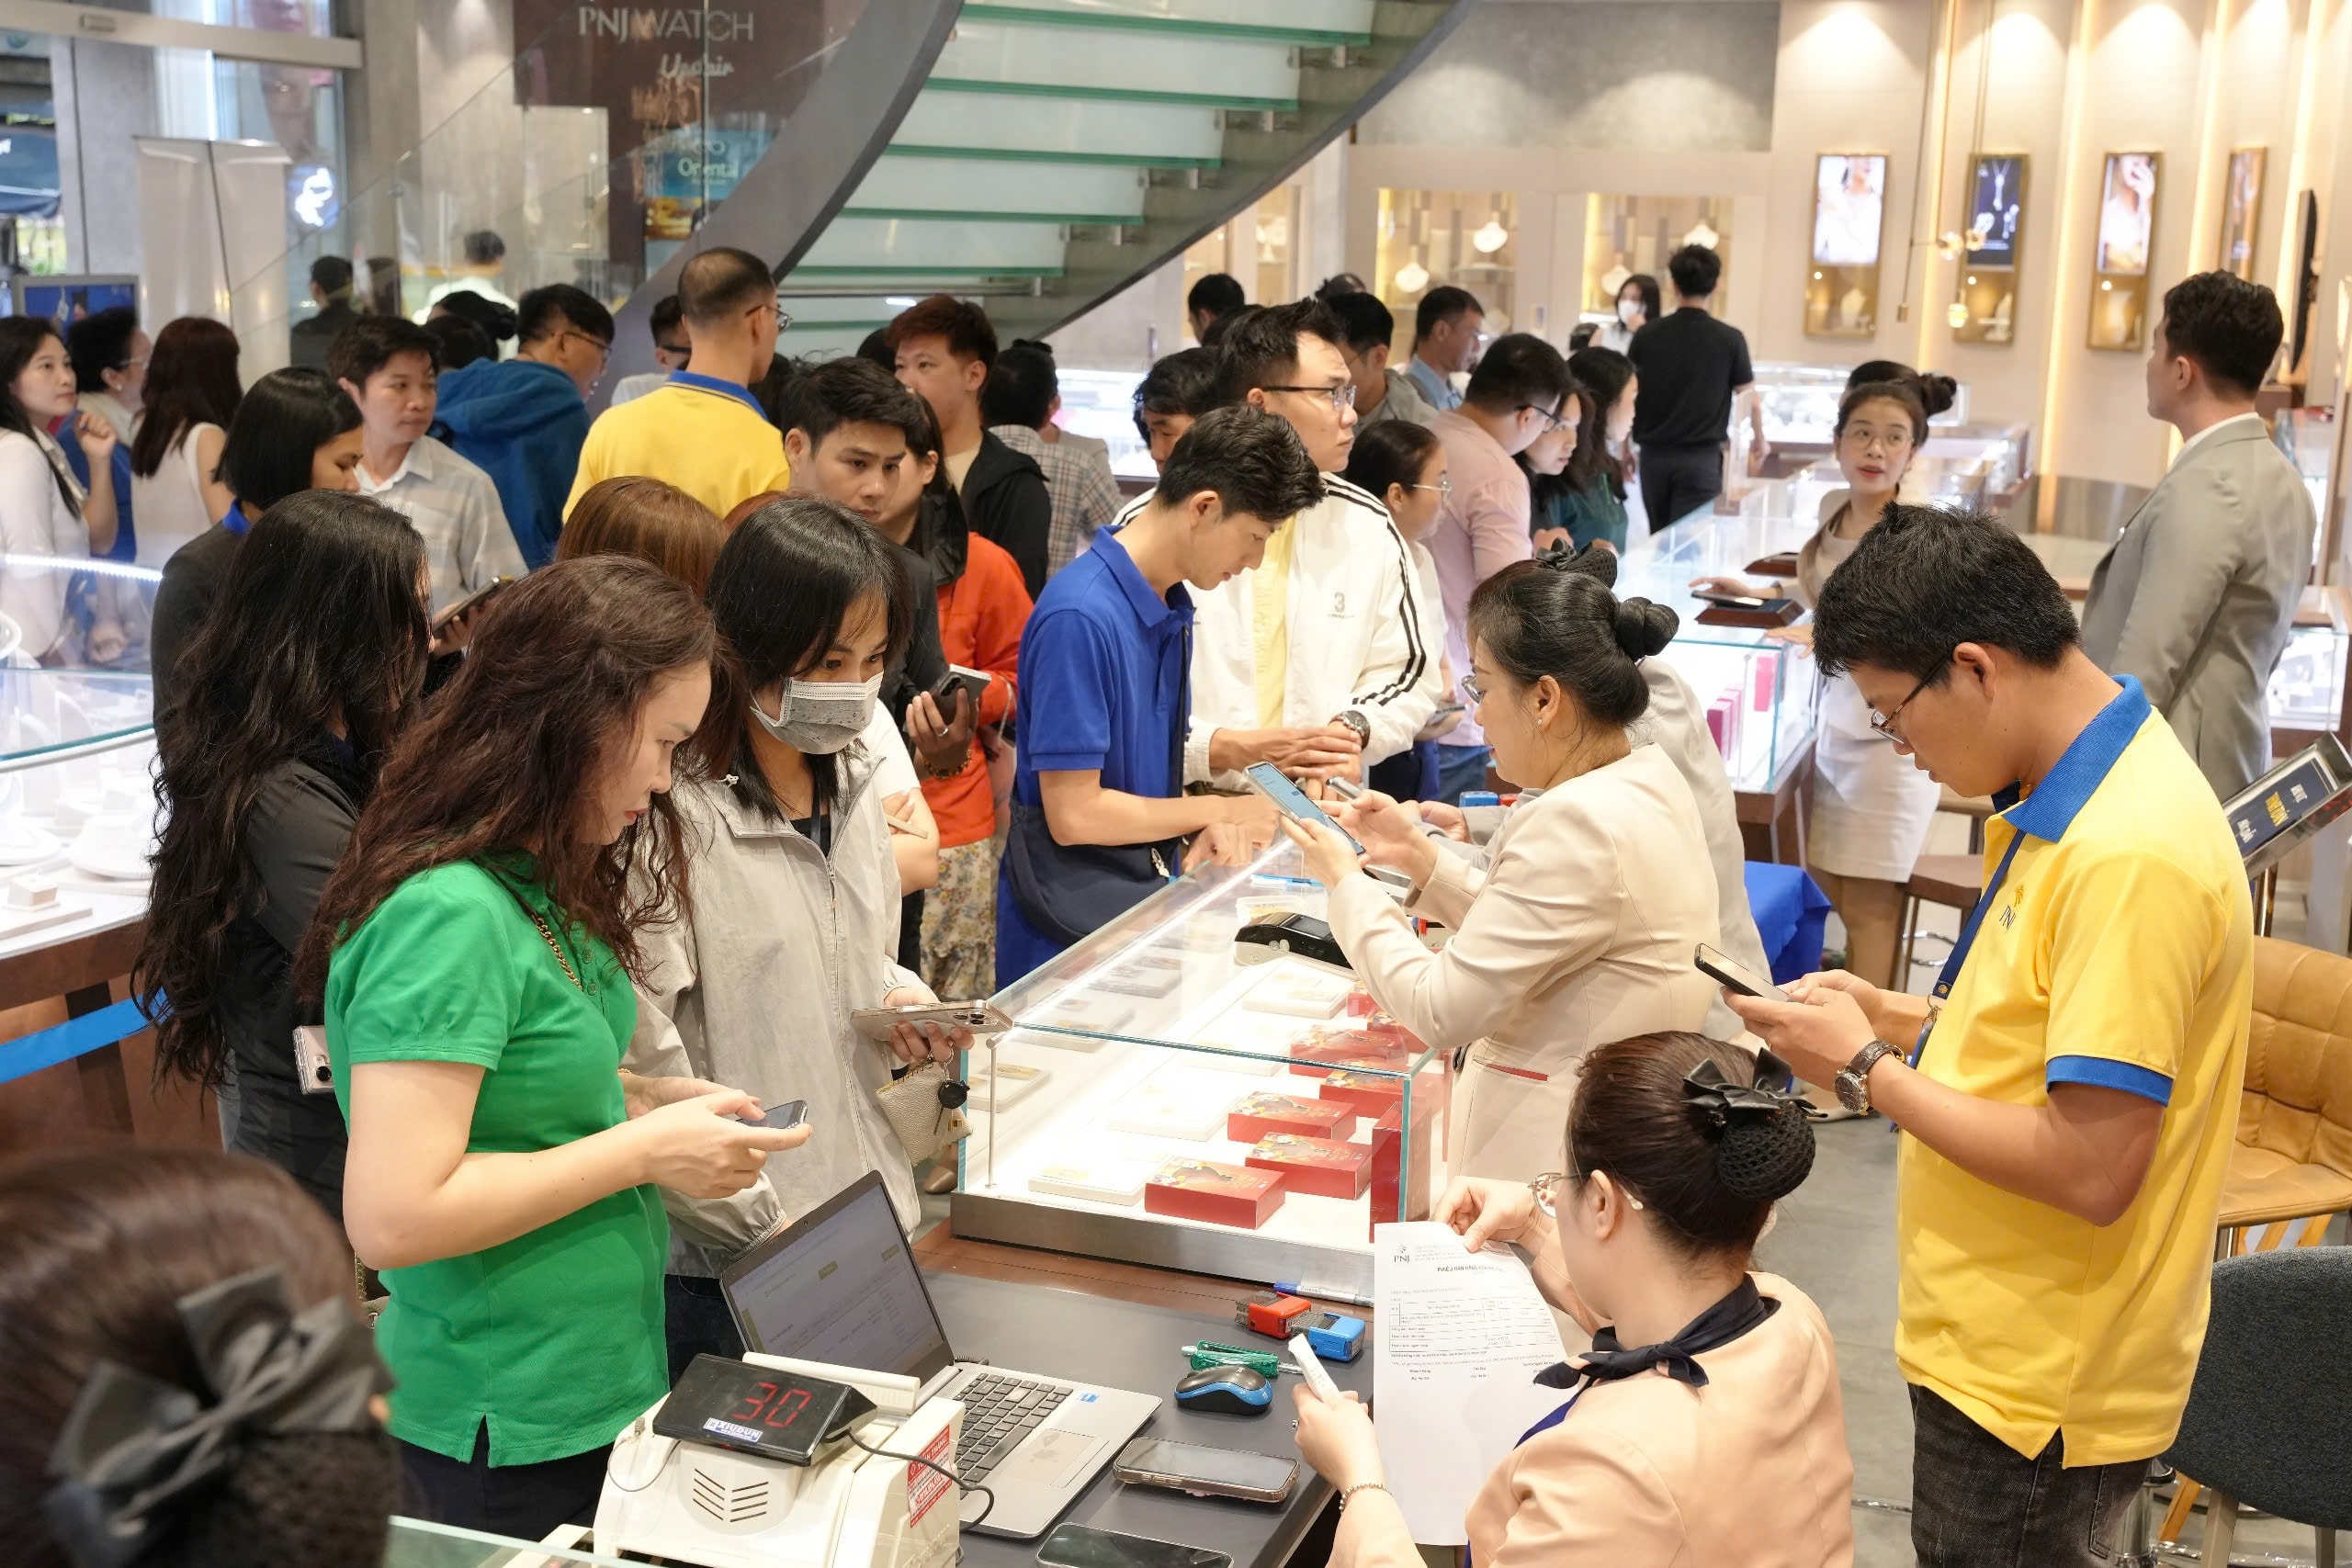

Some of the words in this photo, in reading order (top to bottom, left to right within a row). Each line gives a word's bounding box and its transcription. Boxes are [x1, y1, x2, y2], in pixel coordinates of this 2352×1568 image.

[631, 7, 754, 42] WATCH
[1334, 592, 1346, 613] 3
[730, 1382, 813, 1429] 30
